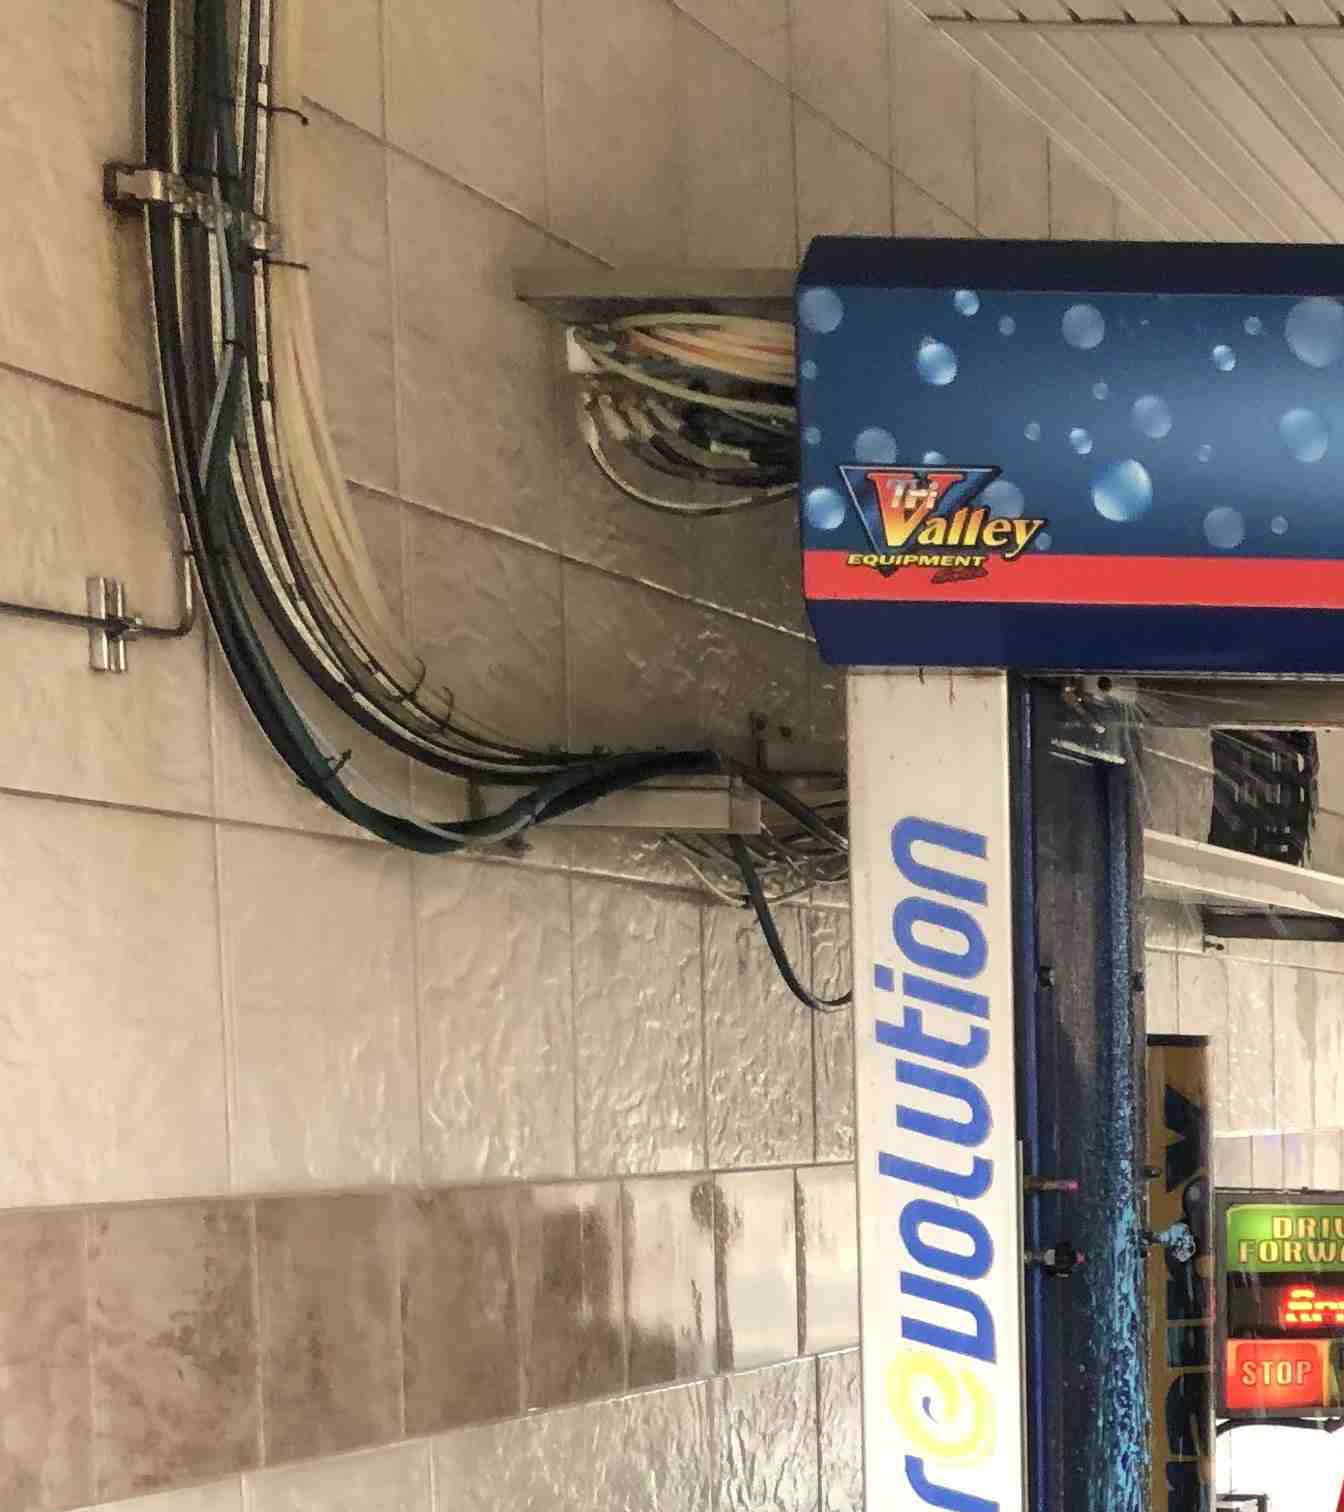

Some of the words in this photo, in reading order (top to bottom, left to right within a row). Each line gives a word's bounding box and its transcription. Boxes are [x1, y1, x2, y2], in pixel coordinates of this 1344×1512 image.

[886, 478, 941, 510] Tri
[866, 472, 1046, 559] Valley
[847, 553, 987, 567] EQUIPMENT
[1241, 1360, 1314, 1387] STOP
